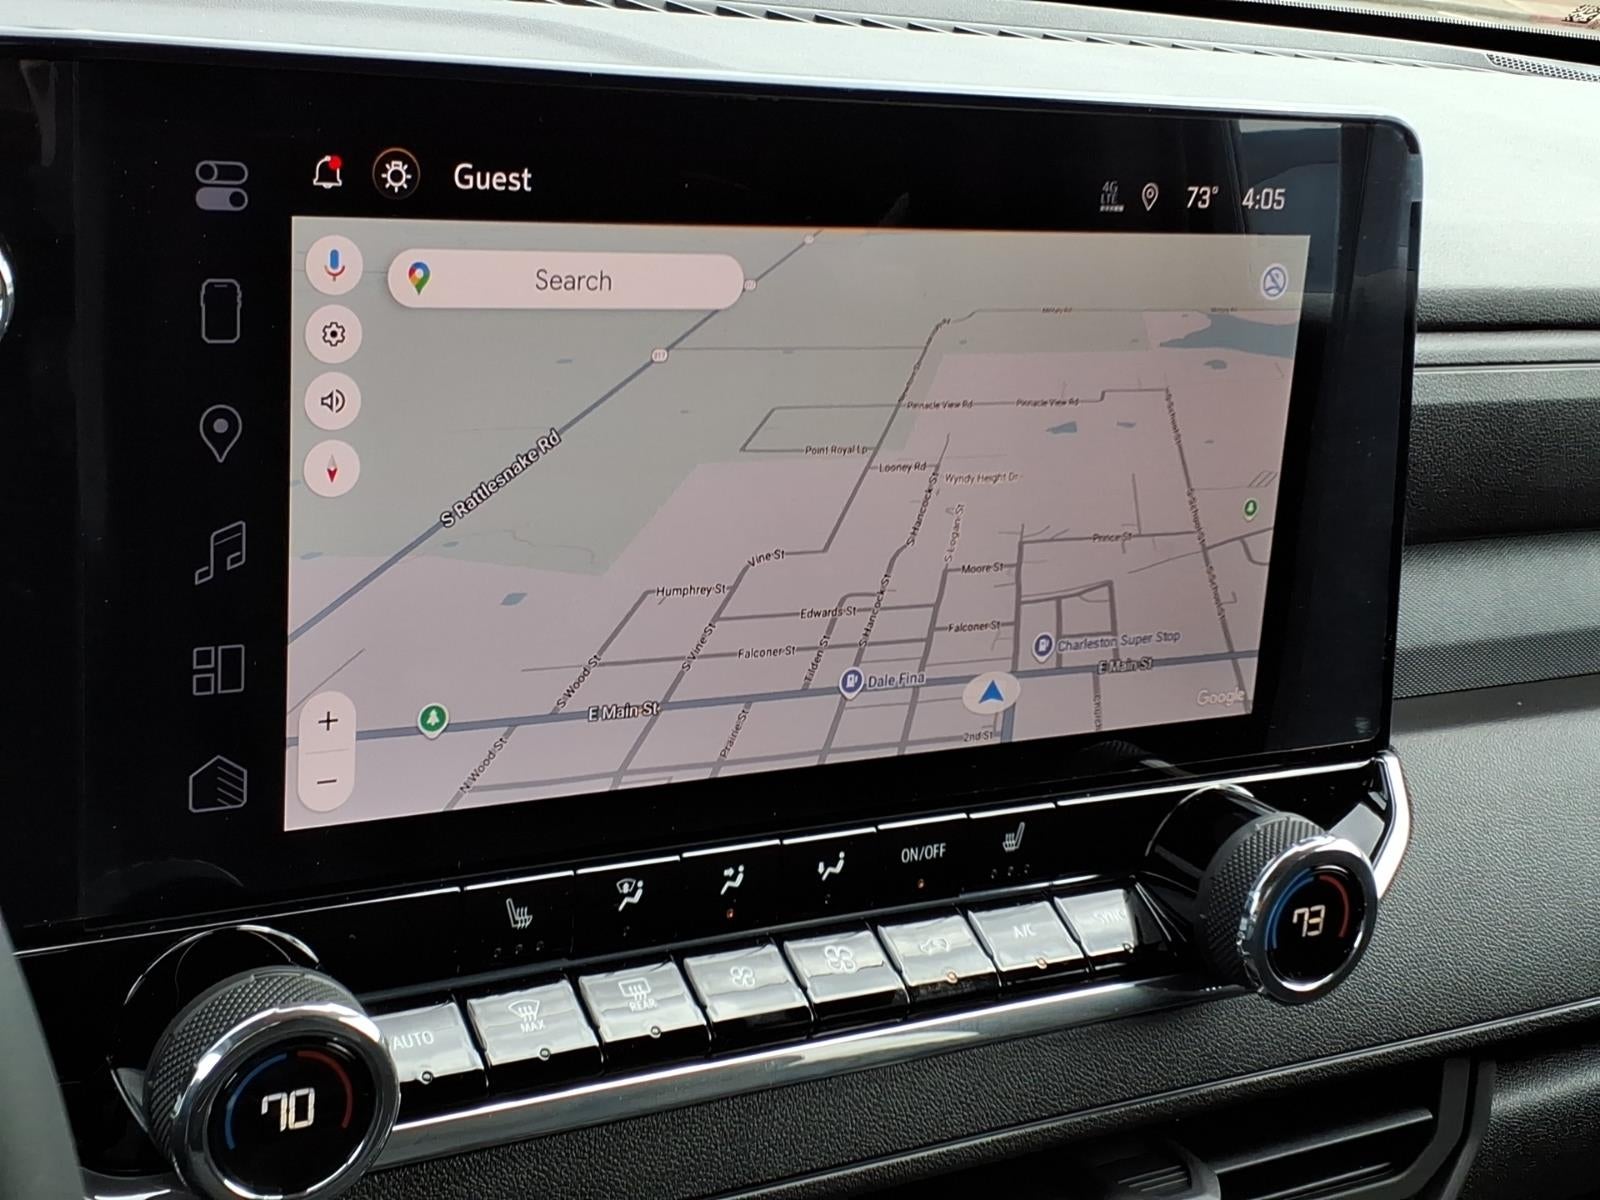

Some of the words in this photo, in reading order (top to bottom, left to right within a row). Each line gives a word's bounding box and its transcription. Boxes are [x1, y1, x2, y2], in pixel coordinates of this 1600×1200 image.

[453, 162, 533, 192] Guest
[1102, 180, 1118, 192] 4G
[1242, 187, 1286, 210] 4:05
[535, 268, 612, 292] Search
[805, 445, 828, 456] Point
[831, 445, 855, 457] Royal
[879, 462, 912, 474] Looney
[914, 462, 927, 472] Rd
[440, 510, 456, 528] S
[453, 448, 539, 519] Rattlesnake
[536, 428, 562, 454] Rd
[928, 472, 940, 488] St
[945, 472, 975, 487] Wyndy
[910, 488, 933, 538] Hancock
[946, 518, 961, 553] Logan
[955, 503, 965, 515] St
[907, 536, 916, 547] S
[1092, 533, 1120, 543] Prince
[1121, 532, 1133, 542] St
[747, 552, 772, 567] Vine
[772, 549, 786, 561] St
[961, 563, 993, 575] Moore
[993, 562, 1004, 573] St
[656, 585, 712, 598] Humphrey
[714, 584, 727, 594] St
[880, 573, 891, 591] St
[800, 607, 843, 620] Edwards
[845, 606, 857, 617] St
[863, 590, 885, 640] Hancock
[948, 621, 989, 634] Falconer
[990, 620, 1000, 631] St
[682, 660, 691, 672] S
[687, 635, 708, 662] Vine
[703, 621, 716, 637] St
[859, 638, 868, 647] S
[1057, 637, 1118, 653] Charleston
[1120, 632, 1153, 649] Super
[1155, 630, 1181, 646] Stop
[738, 646, 783, 660] Falconer
[784, 646, 796, 657] St
[804, 650, 824, 683] Tilden
[820, 634, 831, 650] St
[1097, 660, 1108, 674] E
[1108, 658, 1136, 673] Main
[1136, 656, 1153, 671] St
[556, 698, 567, 710] S
[563, 666, 591, 700] Wood
[588, 653, 602, 668] St
[867, 671, 896, 688] Dale
[898, 670, 926, 686] Fina
[1197, 687, 1246, 707] Google
[587, 706, 600, 722] E
[602, 703, 640, 721] Main
[641, 701, 660, 717] St
[720, 720, 742, 759] Prairie
[738, 708, 750, 722] St
[963, 731, 982, 743] 2nd
[983, 730, 994, 741] St
[460, 781, 471, 794] N
[468, 750, 496, 784] Wood
[493, 736, 508, 752] St
[901, 843, 947, 863] ON/OFF
[1293, 905, 1326, 938] 73
[1013, 923, 1038, 939] A/C
[629, 998, 658, 1013] REAR
[520, 1020, 546, 1033] MAX
[393, 1030, 435, 1051] AUTO
[261, 1087, 316, 1133] 70
